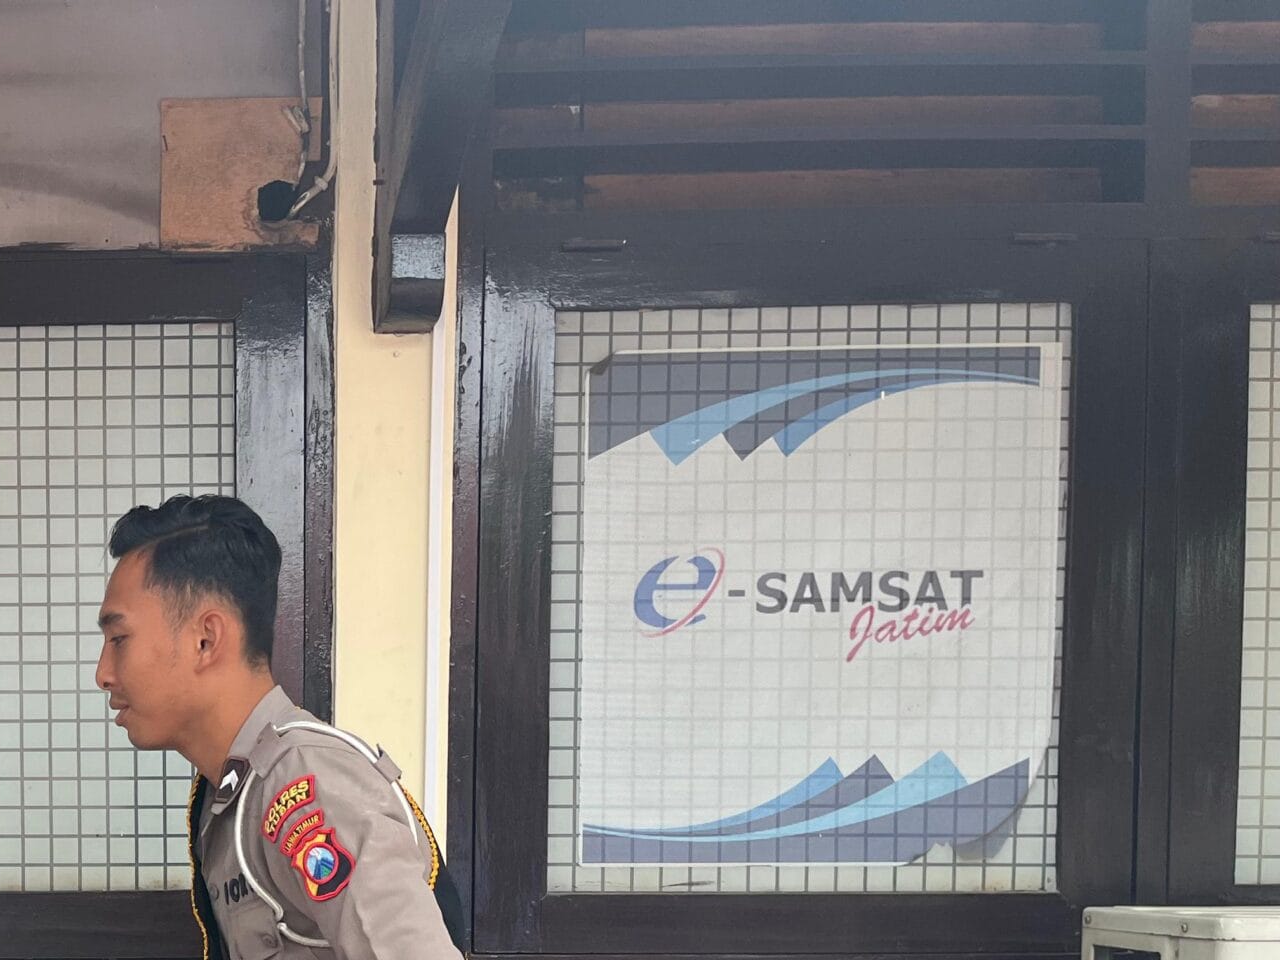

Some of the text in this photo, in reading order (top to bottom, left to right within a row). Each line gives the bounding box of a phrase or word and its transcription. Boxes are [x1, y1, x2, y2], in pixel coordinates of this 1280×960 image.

[634, 554, 984, 630] e-SAMSAT
[846, 605, 975, 663] Jatim
[264, 780, 309, 833] POLRES
[296, 815, 320, 834] TIMUR
